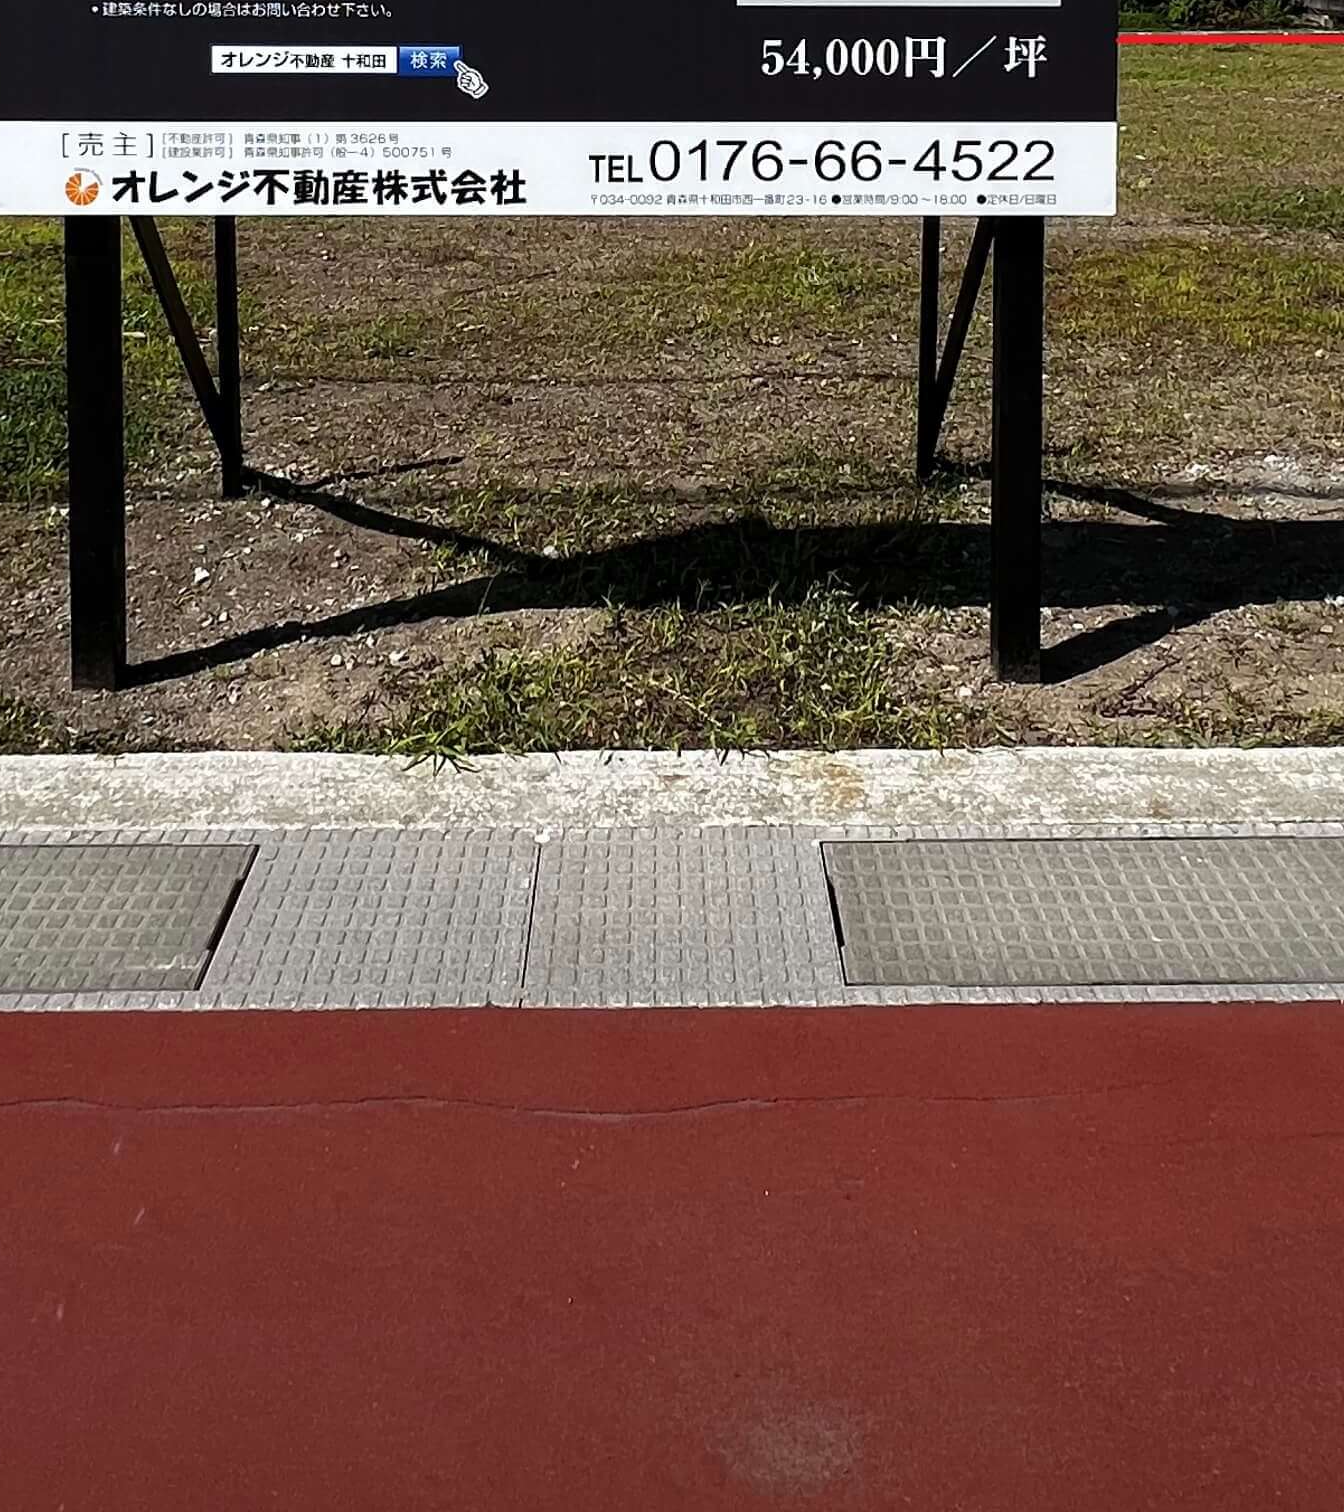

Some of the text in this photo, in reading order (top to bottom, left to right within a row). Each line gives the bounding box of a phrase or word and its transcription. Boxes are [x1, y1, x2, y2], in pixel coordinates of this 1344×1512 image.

[102, 1, 392, 18] 建築条件なしの場合はお問い合わせ下さい。
[221, 51, 386, 69] オレンジ不動産 十和田
[410, 50, 447, 70] 検索
[589, 140, 1054, 182] TEL 0176-66-4522
[113, 170, 526, 205] オレンジ不動産株式会社
